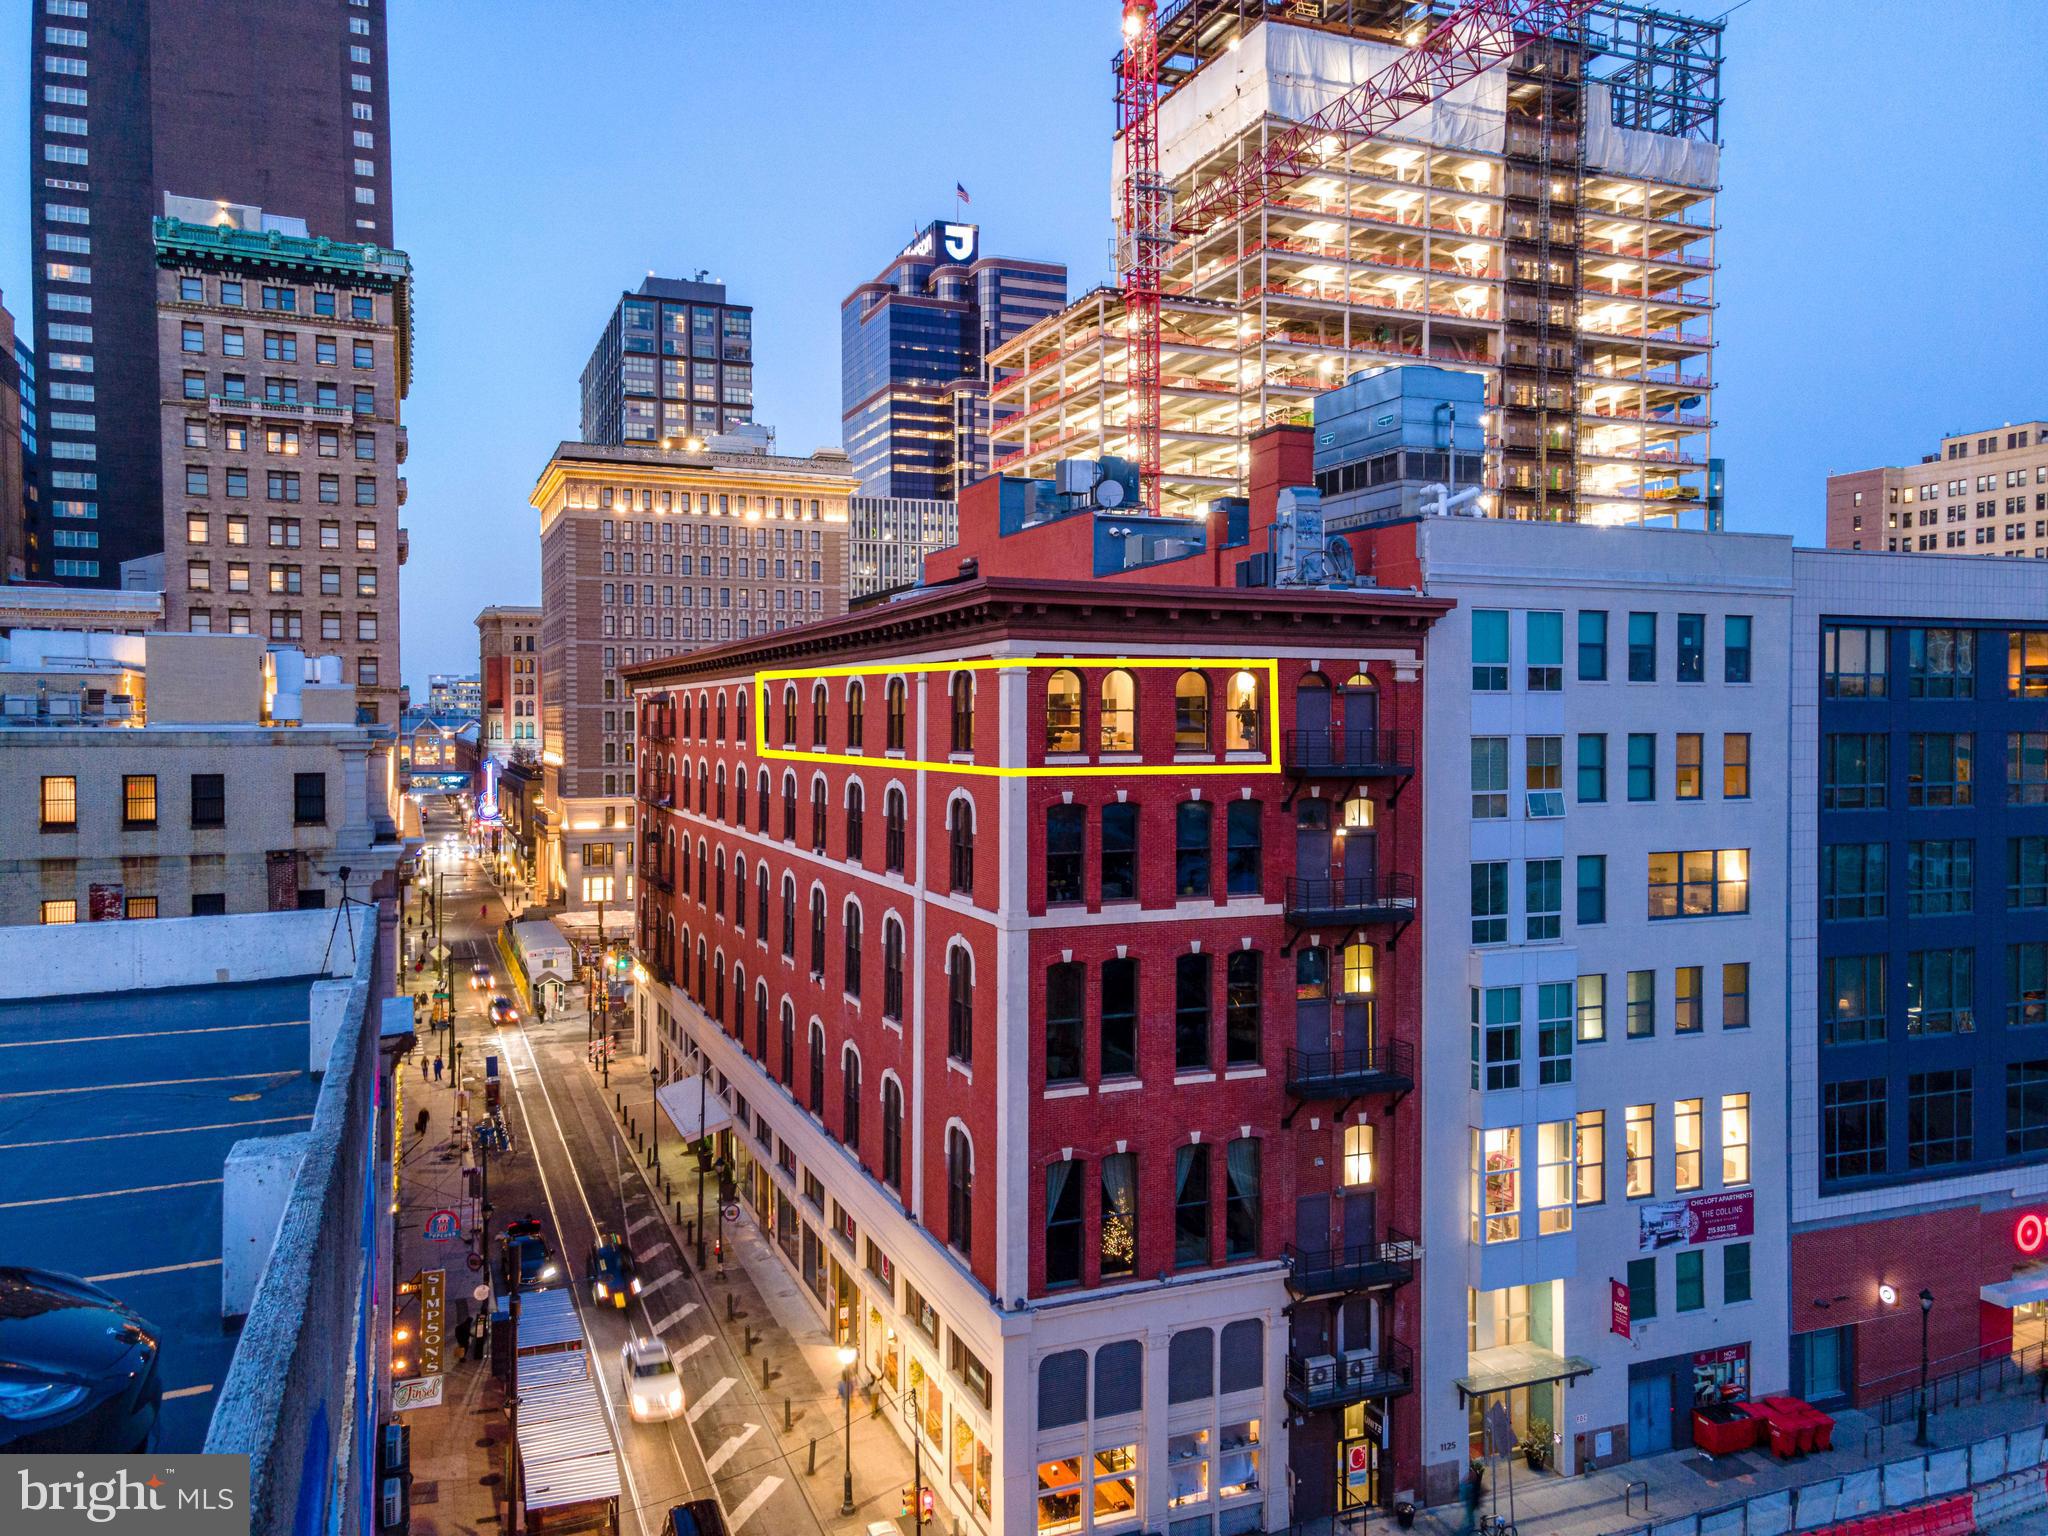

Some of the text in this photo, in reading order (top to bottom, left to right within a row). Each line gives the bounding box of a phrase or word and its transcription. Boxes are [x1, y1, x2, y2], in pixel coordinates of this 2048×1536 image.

[1718, 1192, 1753, 1203] APARTMENTS
[1701, 1205, 1743, 1218] THE COLLINS
[1723, 1350, 1737, 1358] NOW
[395, 1377, 440, 1407] Tinsel
[1440, 1442, 1457, 1451] 1125
